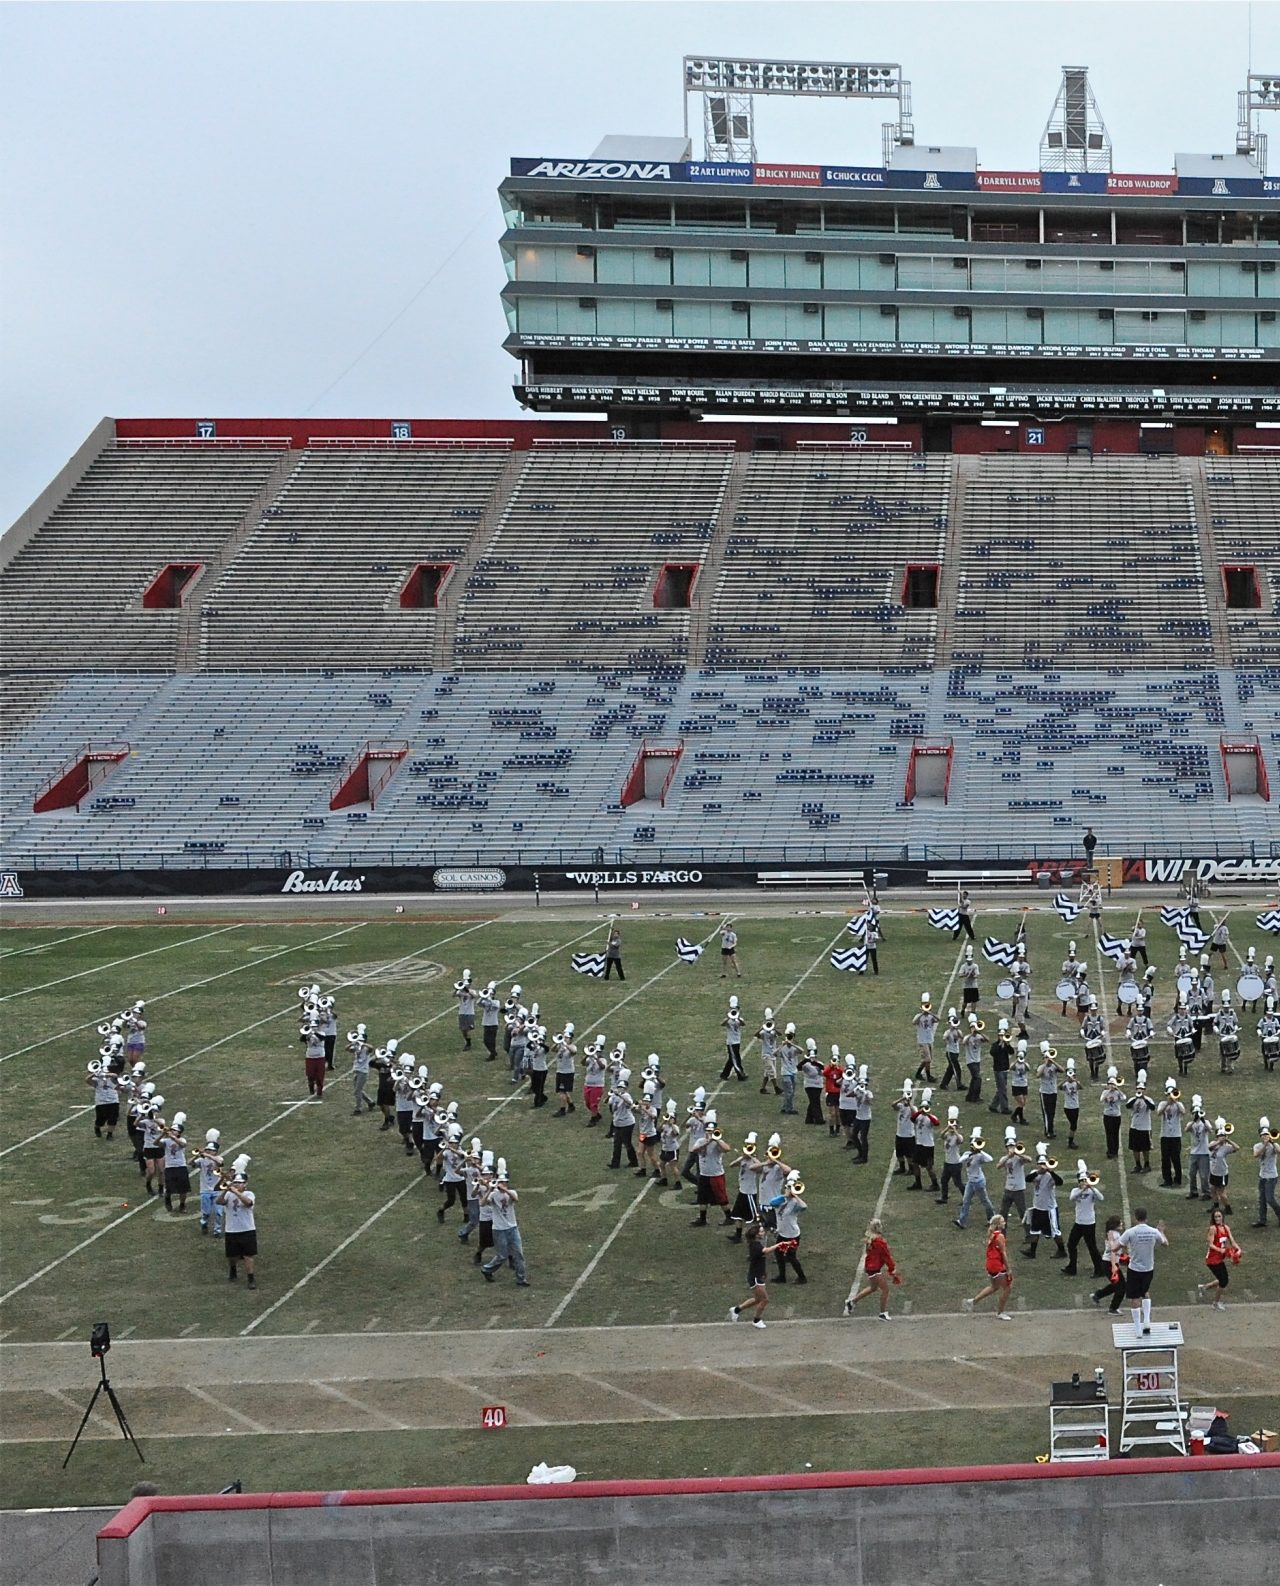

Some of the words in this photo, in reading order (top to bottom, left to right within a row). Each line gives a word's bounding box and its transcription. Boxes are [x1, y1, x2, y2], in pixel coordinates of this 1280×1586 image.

[527, 162, 671, 179] ARIZONA
[690, 166, 700, 177] 22
[700, 167, 715, 177] ART
[717, 168, 750, 178] LUPPINO
[766, 169, 789, 179] RICKY
[791, 170, 820, 180] HUNLEY
[833, 171, 860, 181] CHUCK
[861, 173, 883, 182] CECIL
[977, 175, 983, 185] 4
[984, 176, 1016, 186] DARRYLL
[1018, 177, 1041, 187] LEWIS
[1118, 180, 1133, 189] ROB
[1135, 180, 1171, 189] WALDROP
[199, 427, 213, 438] 17
[394, 427, 409, 439] 18
[611, 429, 626, 440] 19
[851, 431, 867, 442] 20
[1028, 433, 1042, 444] 21
[1027, 859, 1146, 882] ARIZA
[281, 870, 366, 893] Bashas'
[441, 873, 459, 882] SOL
[460, 872, 499, 882] CASINOS
[573, 871, 638, 884] WELLS
[641, 870, 703, 883] FARGO
[0, 873, 24, 897] A
[1140, 1373, 1158, 1390] 50
[484, 1408, 505, 1427] 40
